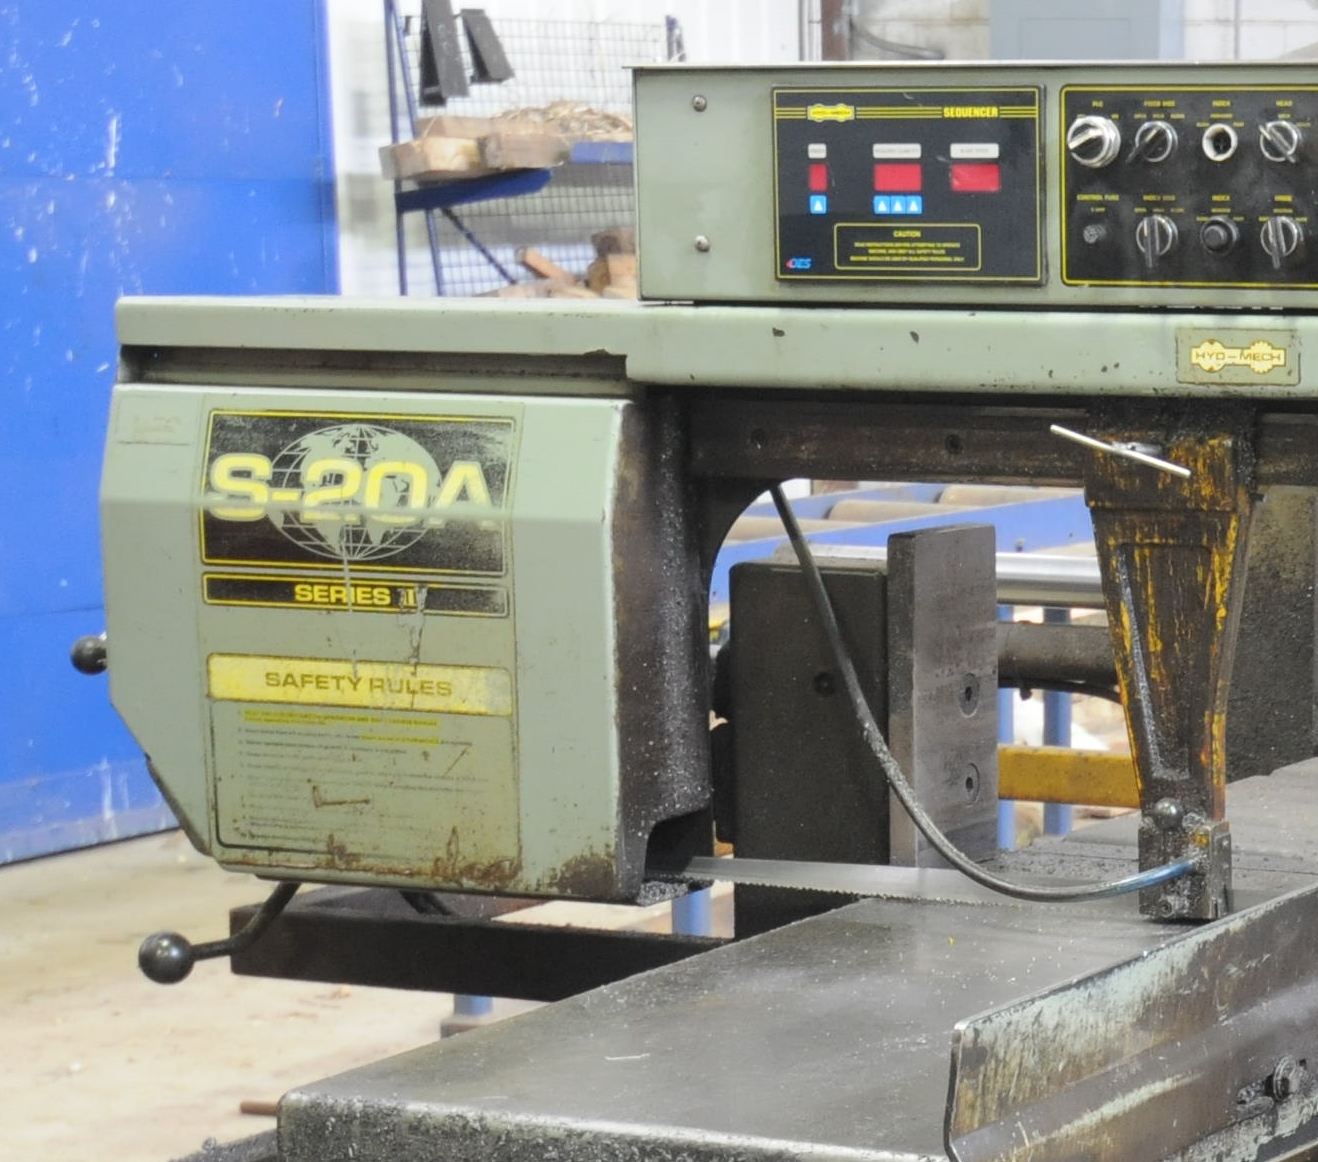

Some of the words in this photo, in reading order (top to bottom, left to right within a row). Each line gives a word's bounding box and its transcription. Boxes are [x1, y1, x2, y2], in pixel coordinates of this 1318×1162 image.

[943, 107, 999, 118] SEQUENCER
[209, 453, 499, 529] S-20A
[295, 585, 391, 605] SERIES
[265, 671, 362, 692] SAFETY
[369, 678, 453, 697] RULES
